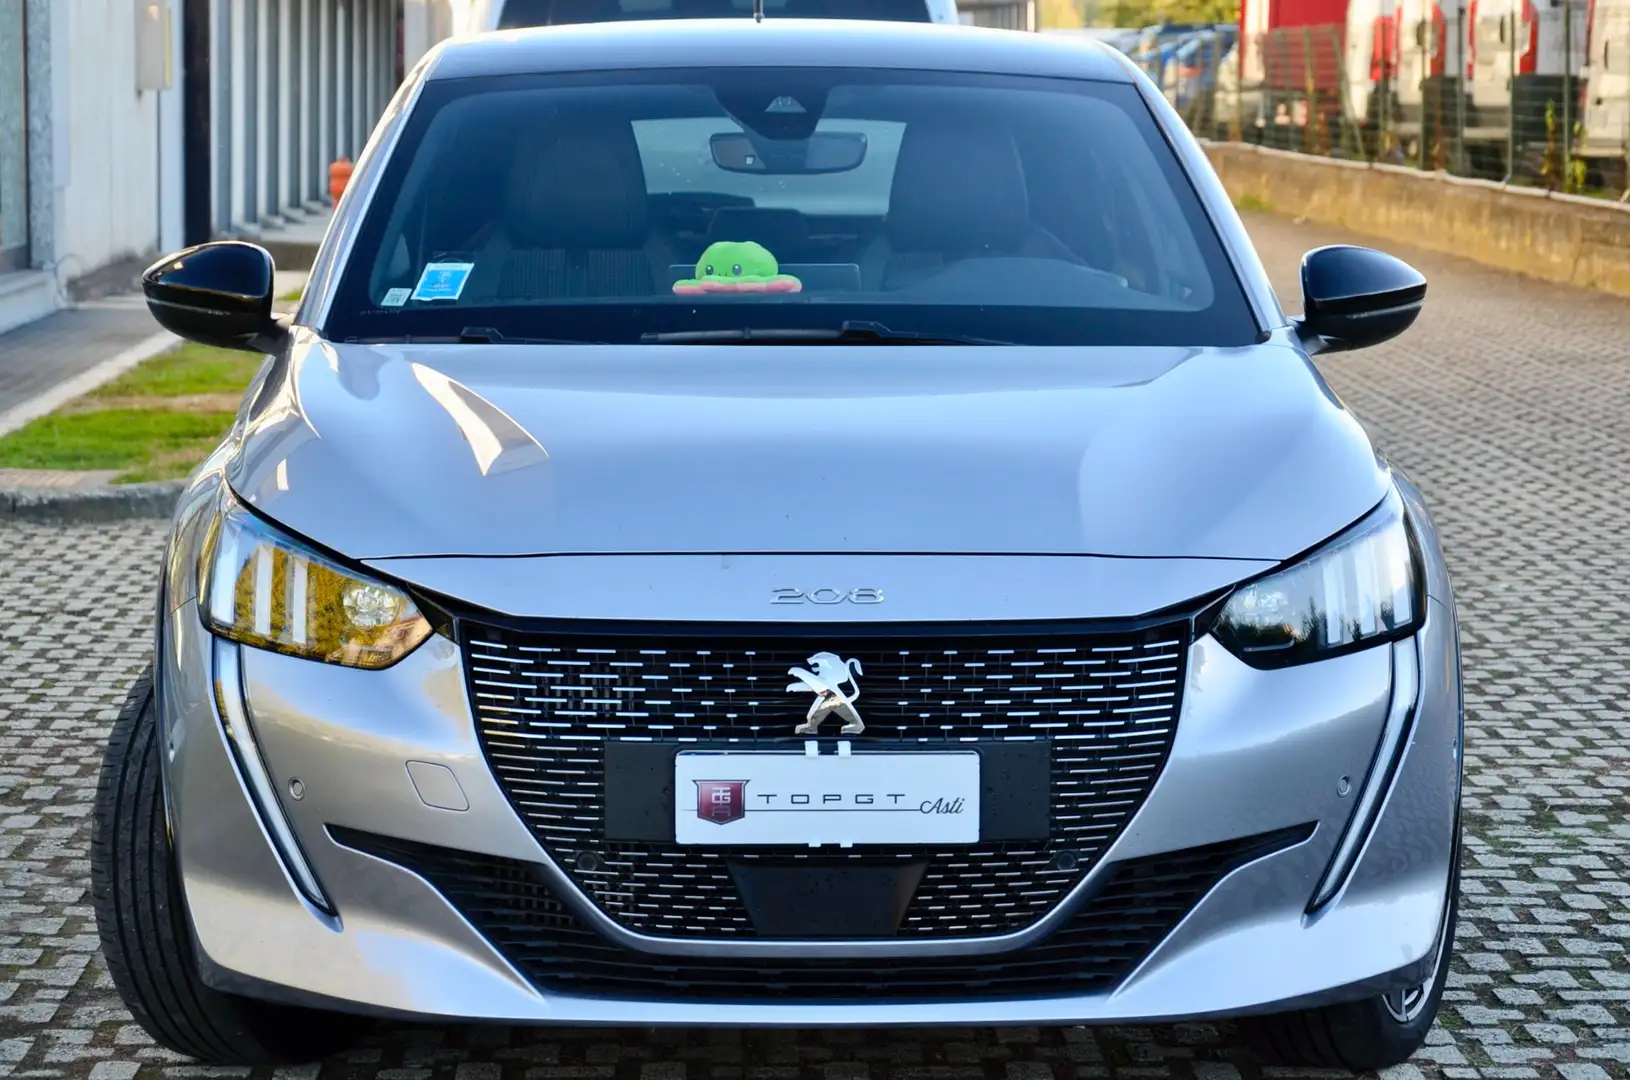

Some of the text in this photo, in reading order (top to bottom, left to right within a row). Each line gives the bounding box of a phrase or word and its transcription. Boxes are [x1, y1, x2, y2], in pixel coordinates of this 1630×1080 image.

[769, 588, 884, 604] 208
[757, 793, 966, 815] TOPGT Asti
